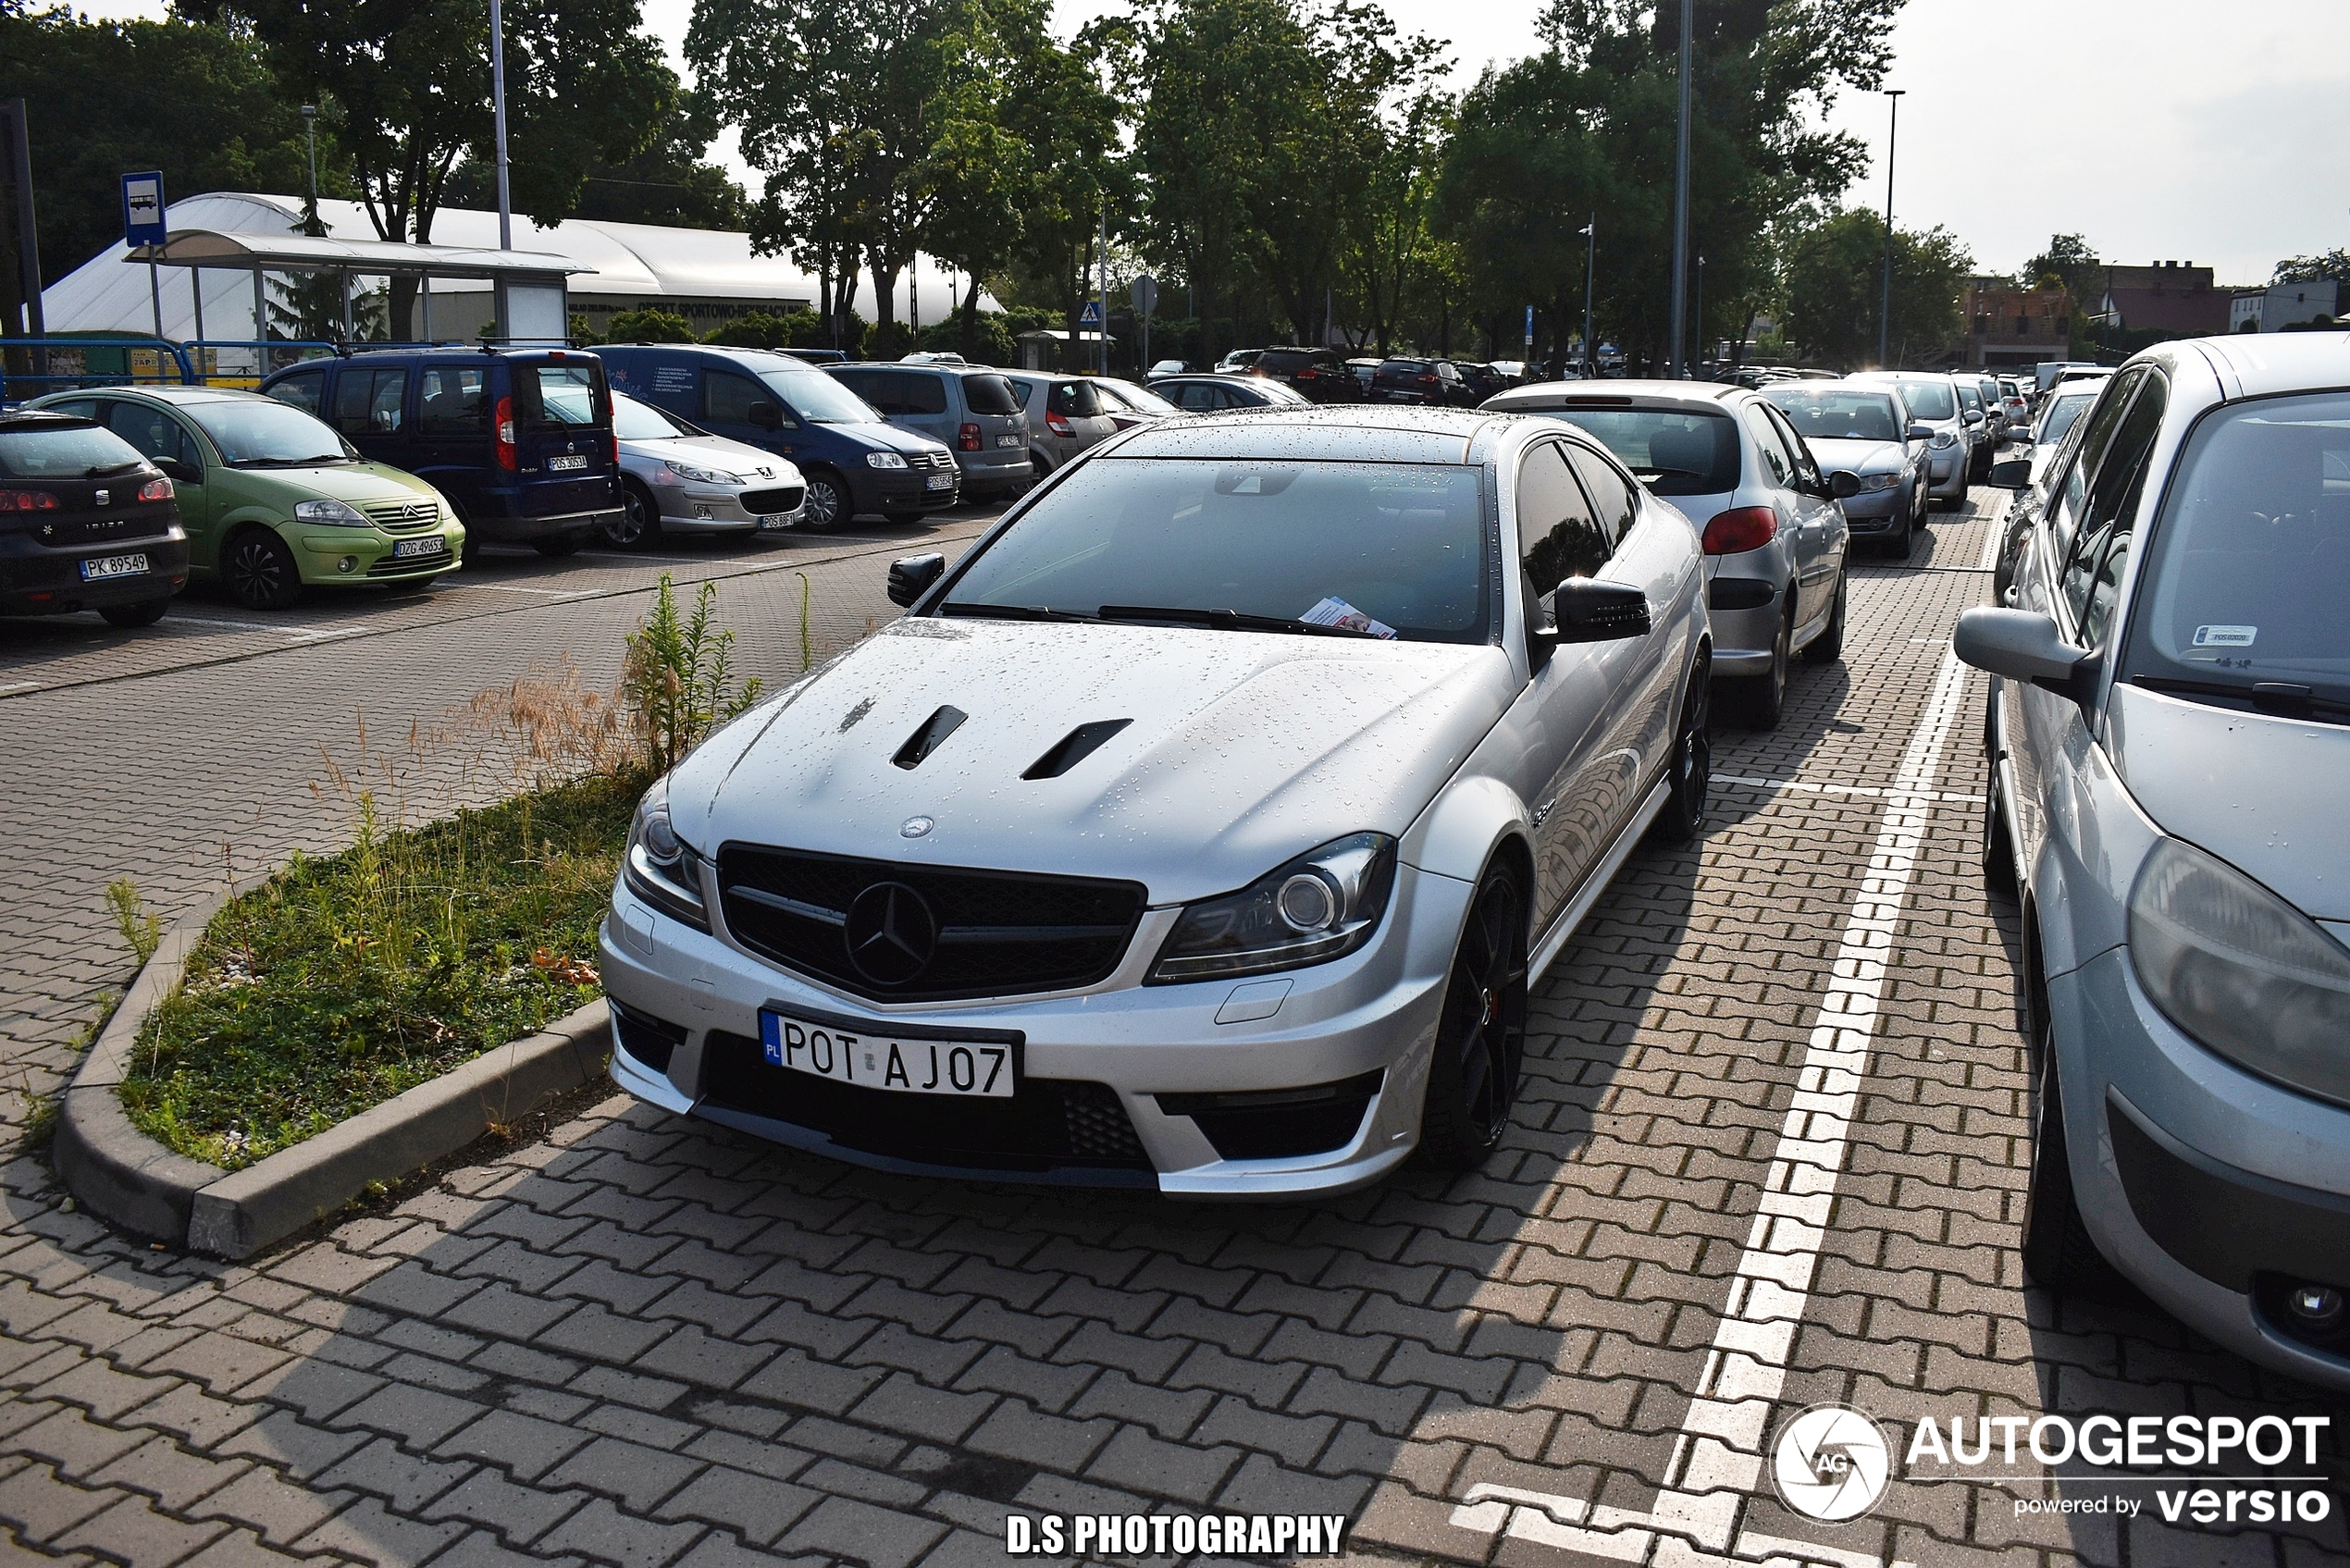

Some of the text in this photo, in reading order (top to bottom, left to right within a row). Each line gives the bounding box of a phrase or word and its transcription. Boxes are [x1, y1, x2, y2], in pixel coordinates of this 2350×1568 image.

[551, 458, 566, 470] POS
[929, 476, 939, 487] POS
[764, 516, 778, 527] POS
[399, 538, 443, 555] DZG 49653
[88, 555, 145, 575] PK 89549
[766, 1043, 779, 1058] PL
[784, 1022, 1006, 1093] POT AJ07
